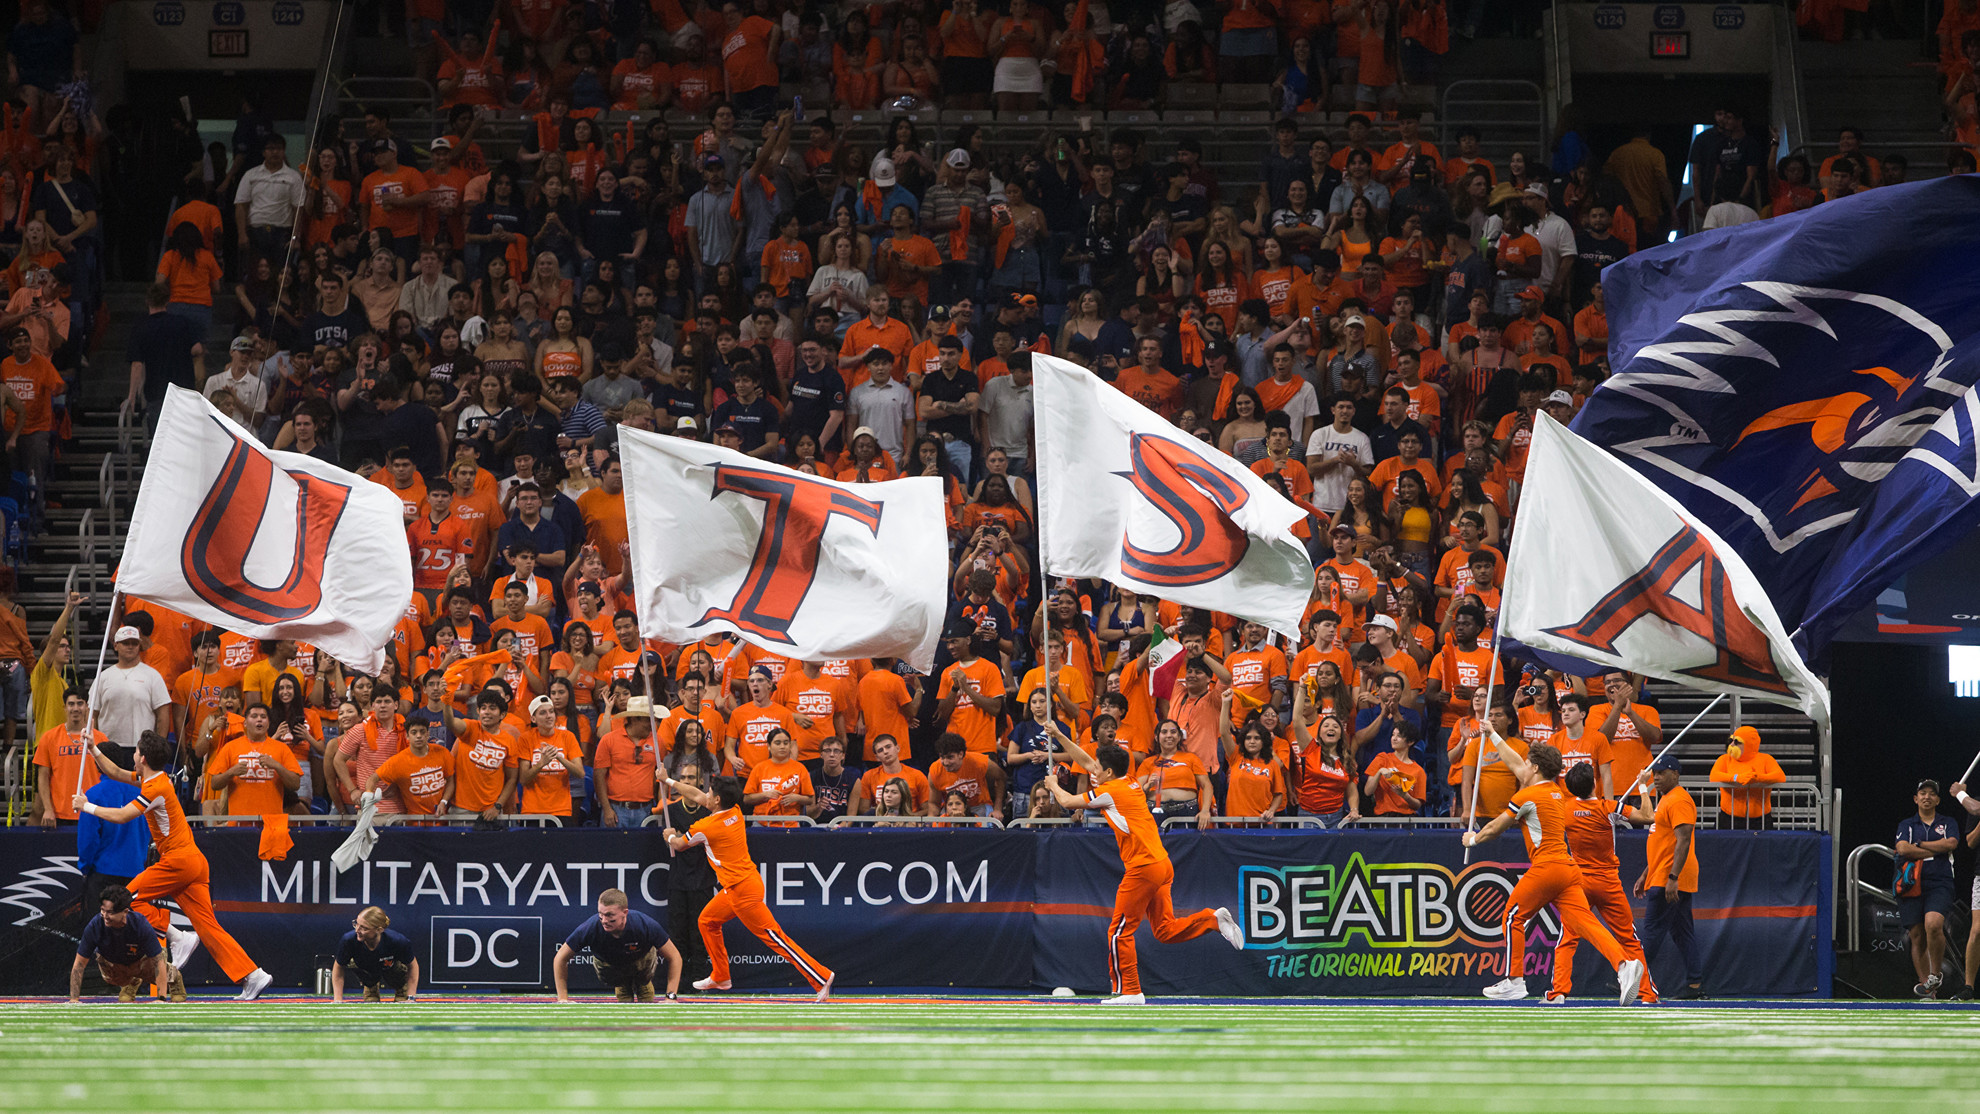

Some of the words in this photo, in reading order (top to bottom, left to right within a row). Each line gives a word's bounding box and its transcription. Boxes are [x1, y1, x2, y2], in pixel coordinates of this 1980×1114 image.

[163, 12, 183, 22] 123
[220, 12, 237, 22] C1
[1603, 16, 1623, 26] 124
[1660, 15, 1678, 25] C2
[1715, 16, 1736, 26] 125
[216, 34, 241, 52] EXIT
[1657, 36, 1682, 54] EXIT
[1578, 252, 1616, 260] FOOTBALL
[1262, 282, 1292, 296] BIRD
[1264, 290, 1288, 302] CAG
[315, 325, 348, 342] UTSA
[1676, 424, 1700, 440] TM
[1324, 442, 1358, 454] UTSA
[1108, 430, 1250, 587] S
[181, 414, 352, 626] U
[416, 548, 452, 570] 25
[687, 462, 884, 646] T
[1539, 510, 1802, 700] A
[1066, 640, 1073, 666] 1
[224, 655, 252, 667] CAG
[822, 666, 850, 676] AGE
[1232, 664, 1262, 675] BIRD
[1232, 674, 1264, 683] CAGE
[192, 685, 222, 700] UTS
[798, 694, 832, 705] BIRD
[796, 704, 832, 714] CAGE
[746, 724, 782, 734] BIRD
[58, 745, 90, 756] UTS
[474, 744, 506, 760] BIRD
[1238, 760, 1270, 778] UTSA
[411, 770, 444, 786] BIRD
[409, 780, 446, 795] CAGE
[261, 860, 988, 906] MILITARYATTOEY.COM
[446, 928, 520, 968] DC
[1871, 939, 1904, 952] SOSA
[1266, 954, 1306, 978] THE
[1309, 953, 1405, 977] ORIGINAL
[1408, 952, 1477, 977] PARTY
[1477, 952, 1551, 977] PUCH
